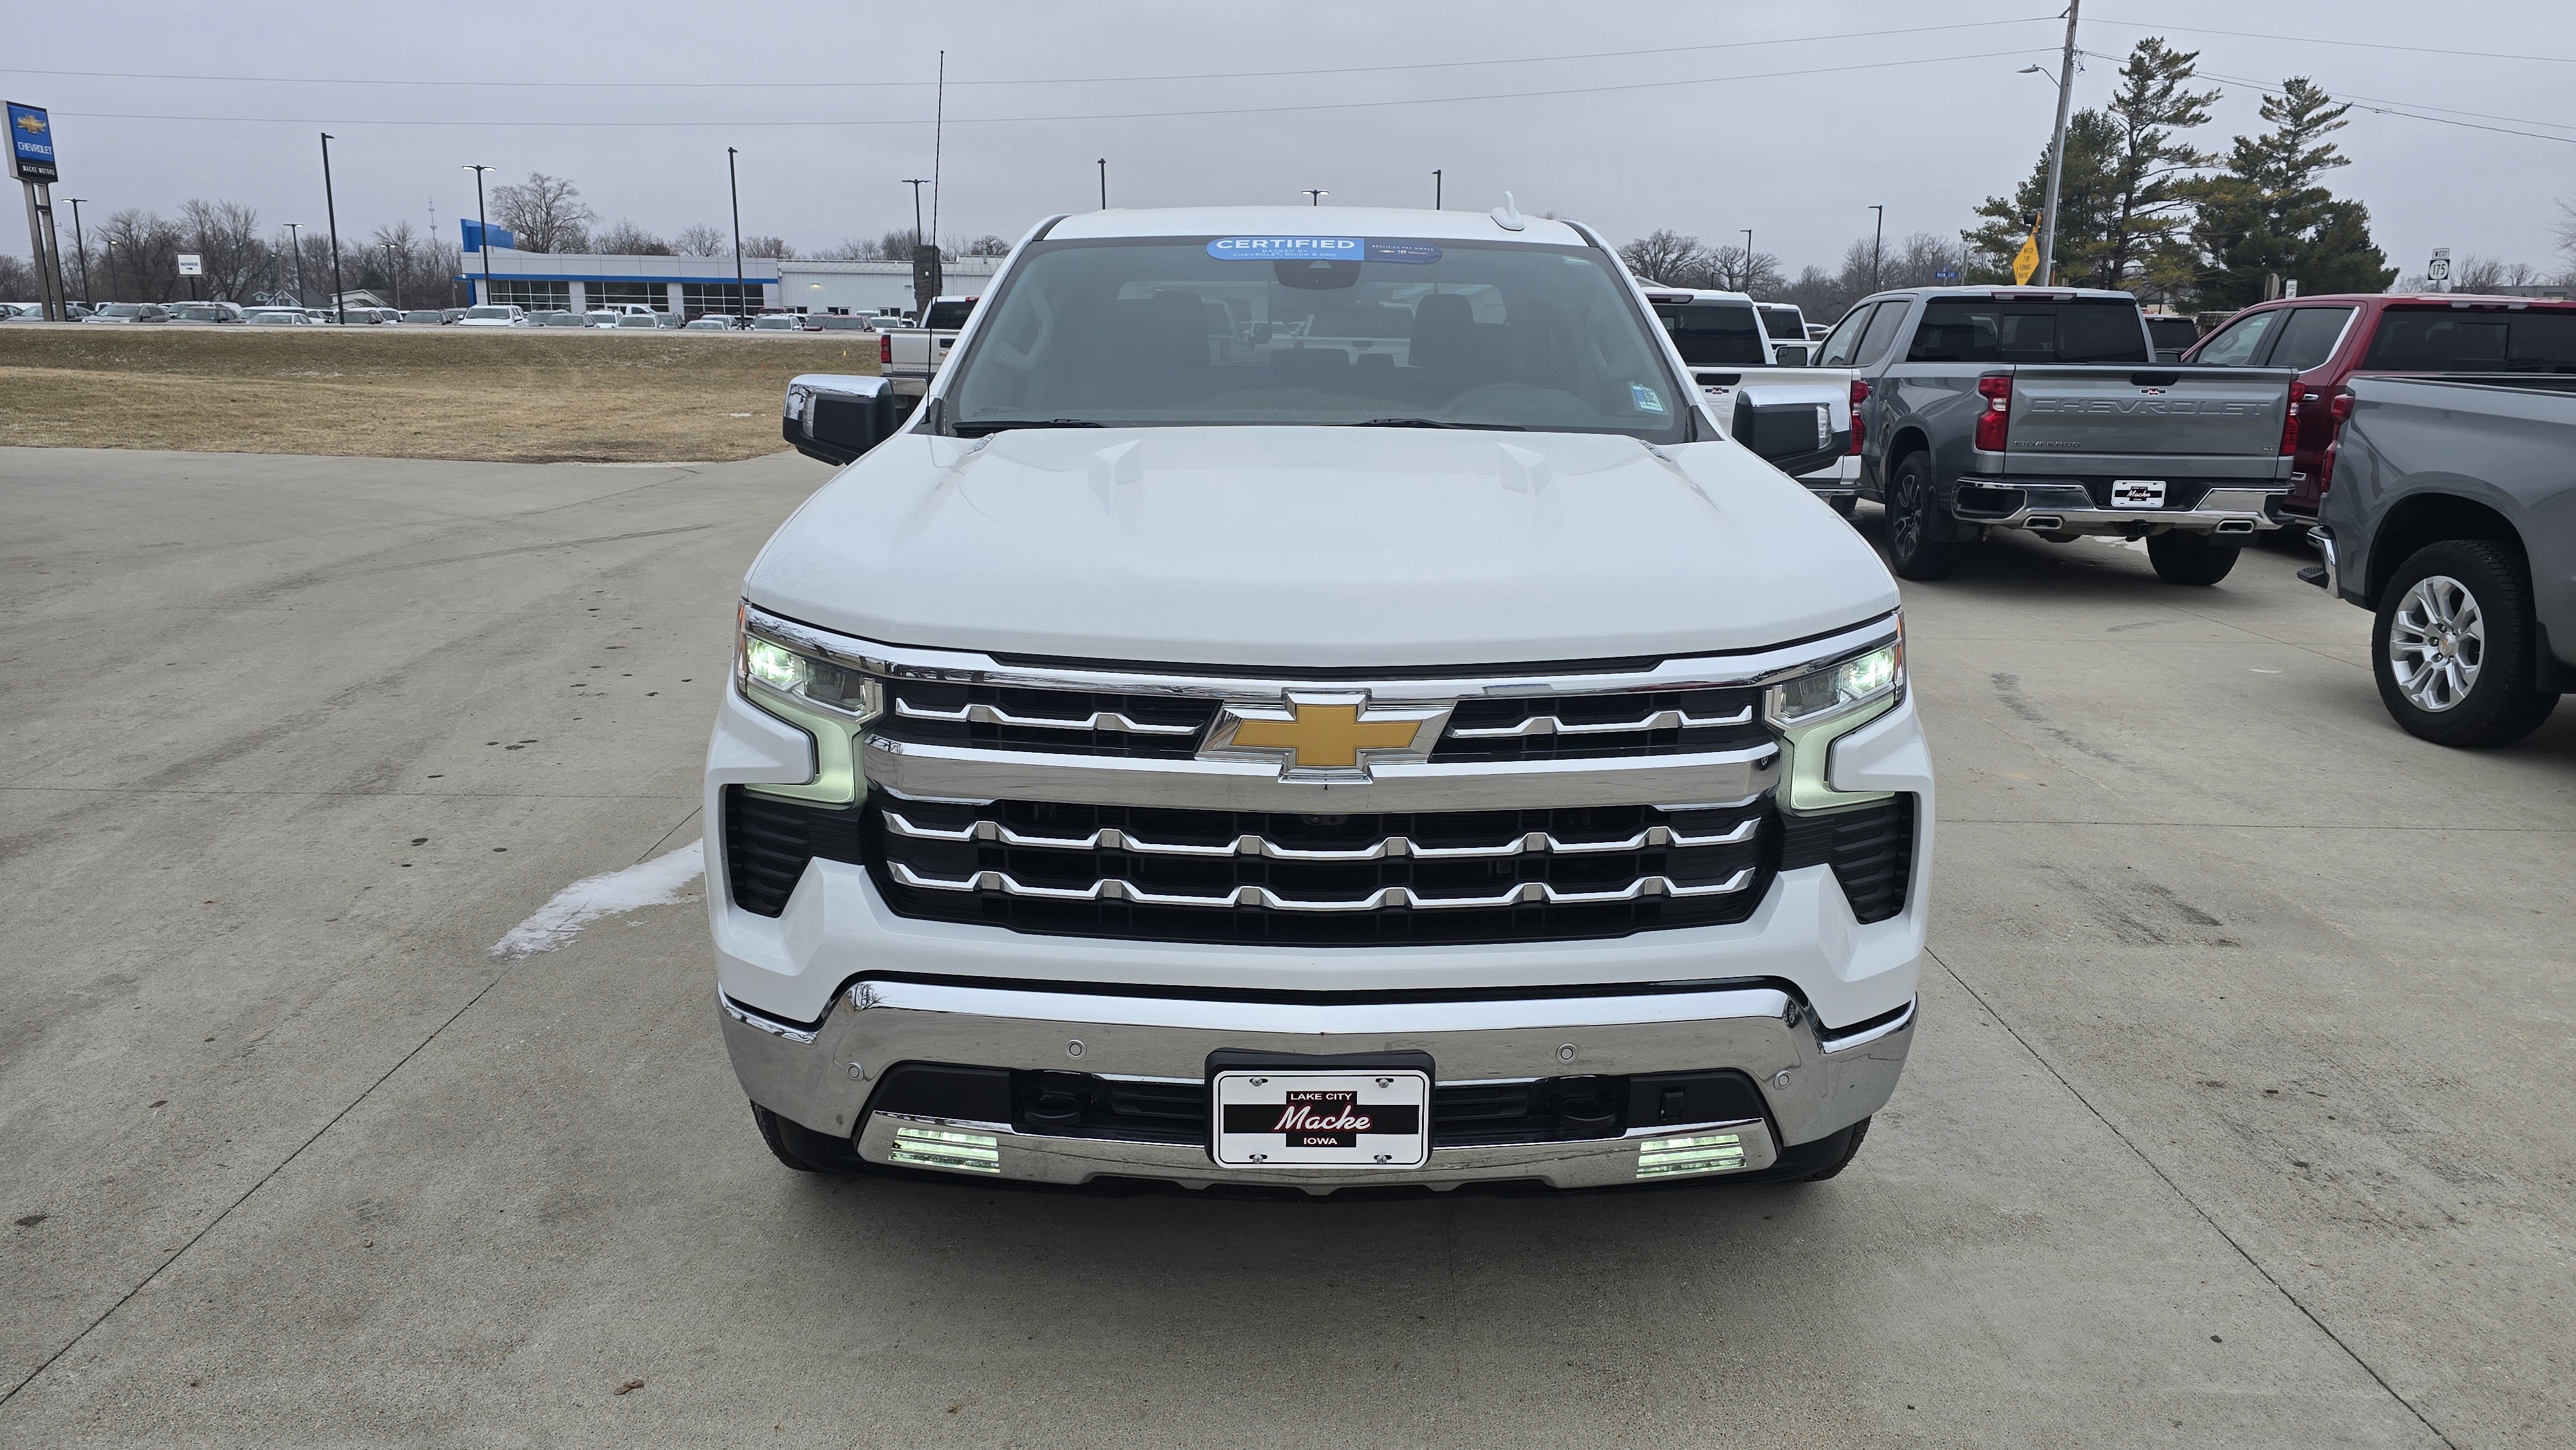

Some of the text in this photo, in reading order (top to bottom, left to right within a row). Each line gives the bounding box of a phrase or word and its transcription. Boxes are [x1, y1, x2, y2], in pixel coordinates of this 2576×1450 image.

[17, 142, 52, 155] CHEVROLET
[39, 167, 55, 176] MOTORS
[1216, 239, 1355, 249] CERTIFIED
[2432, 264, 2445, 276] 175
[2031, 398, 2271, 416] CHEVROLET
[1274, 1104, 1371, 1130] Macke
